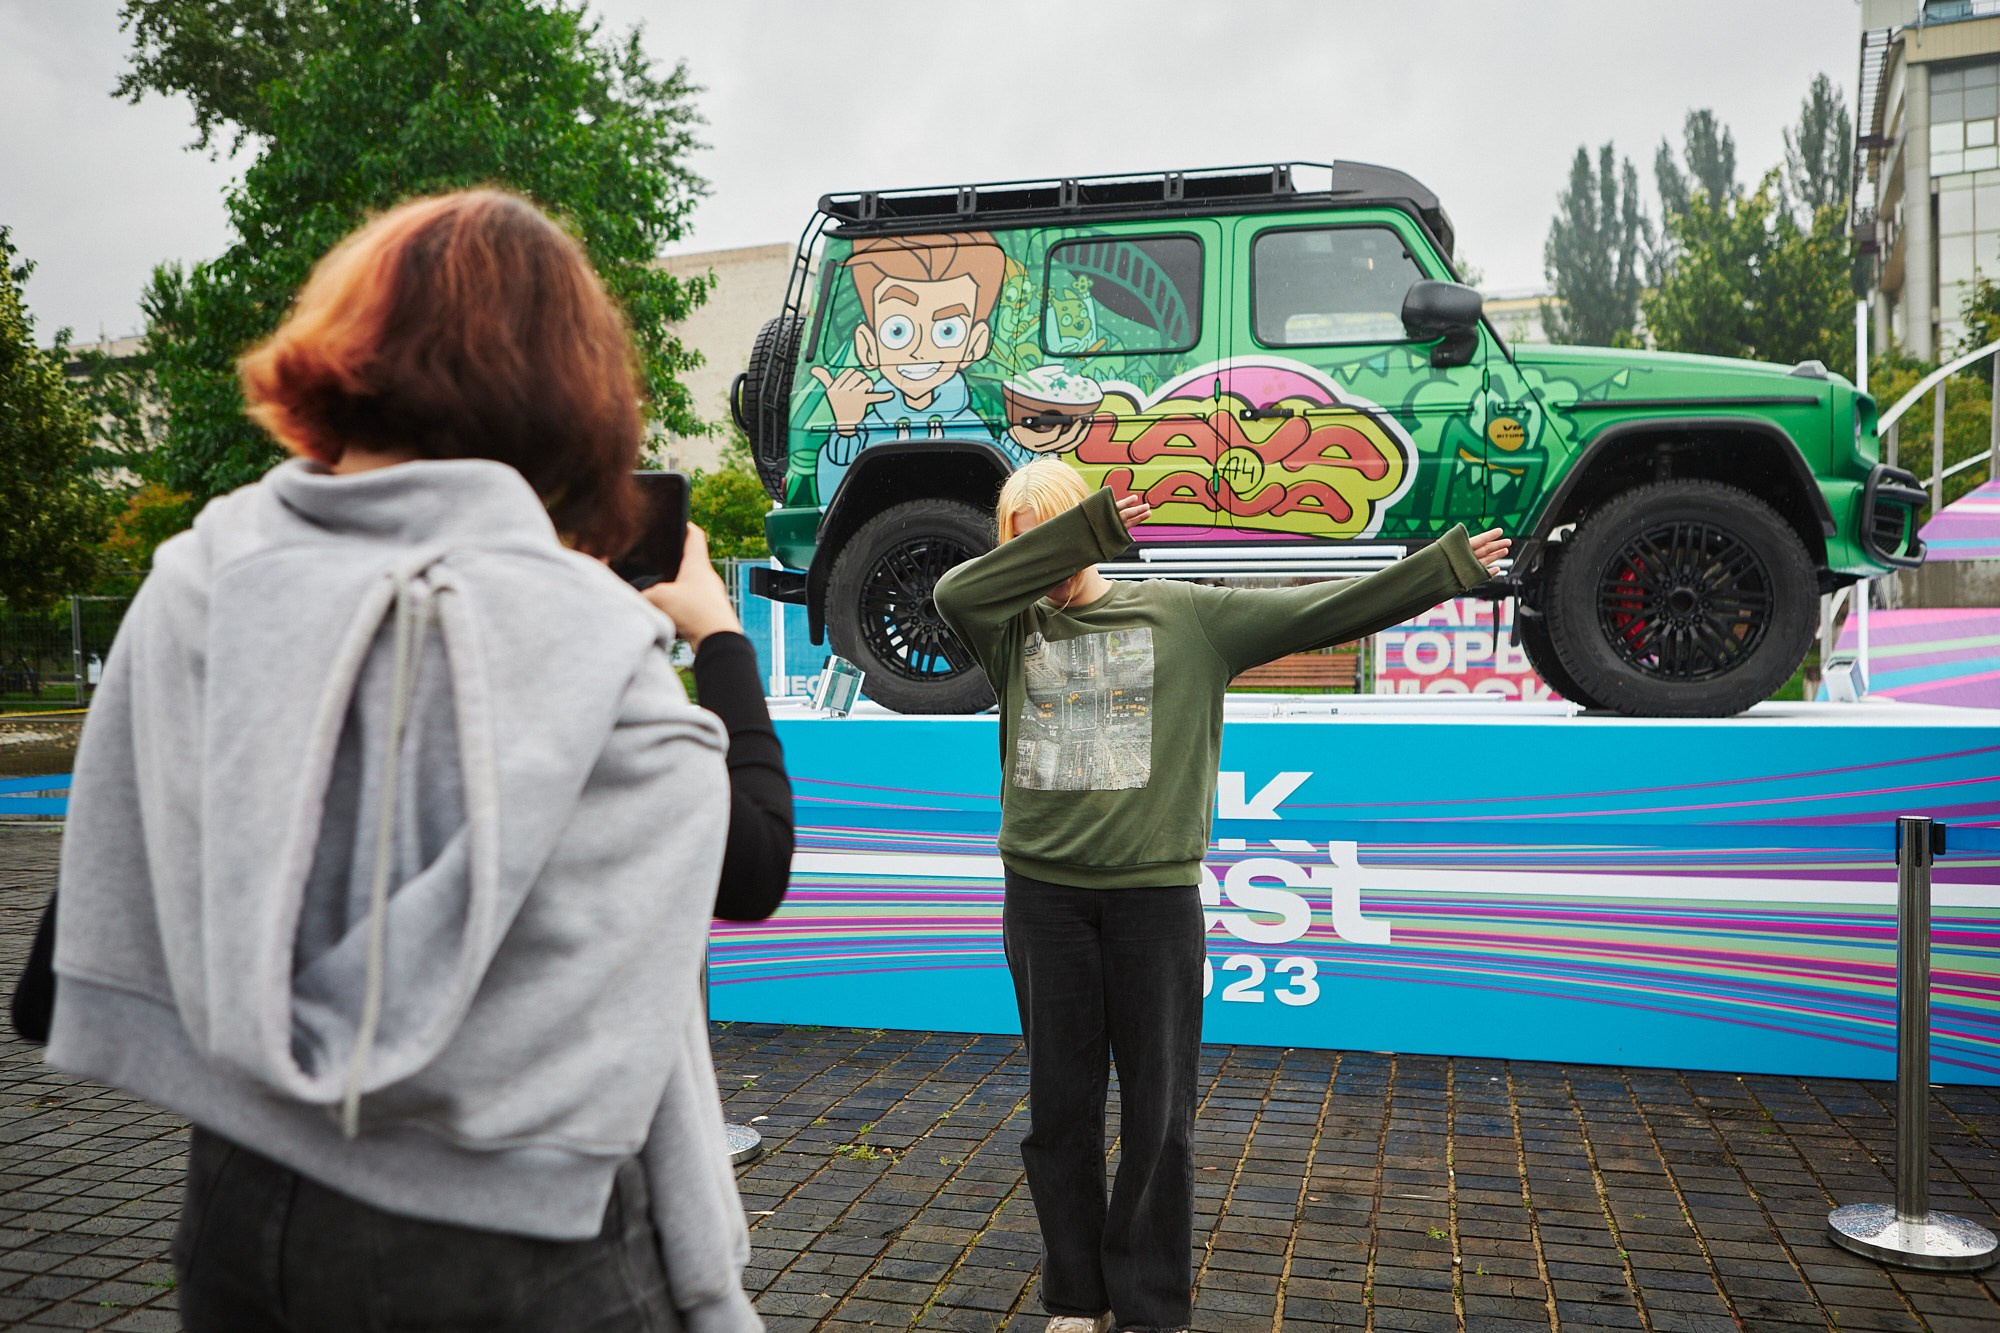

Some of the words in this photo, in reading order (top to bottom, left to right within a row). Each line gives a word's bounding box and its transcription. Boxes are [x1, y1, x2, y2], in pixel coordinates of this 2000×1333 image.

[1076, 409, 1389, 480] LAVA
[1219, 456, 1256, 484] A4
[1200, 840, 1391, 944] st
[1203, 954, 1320, 1006] 23
